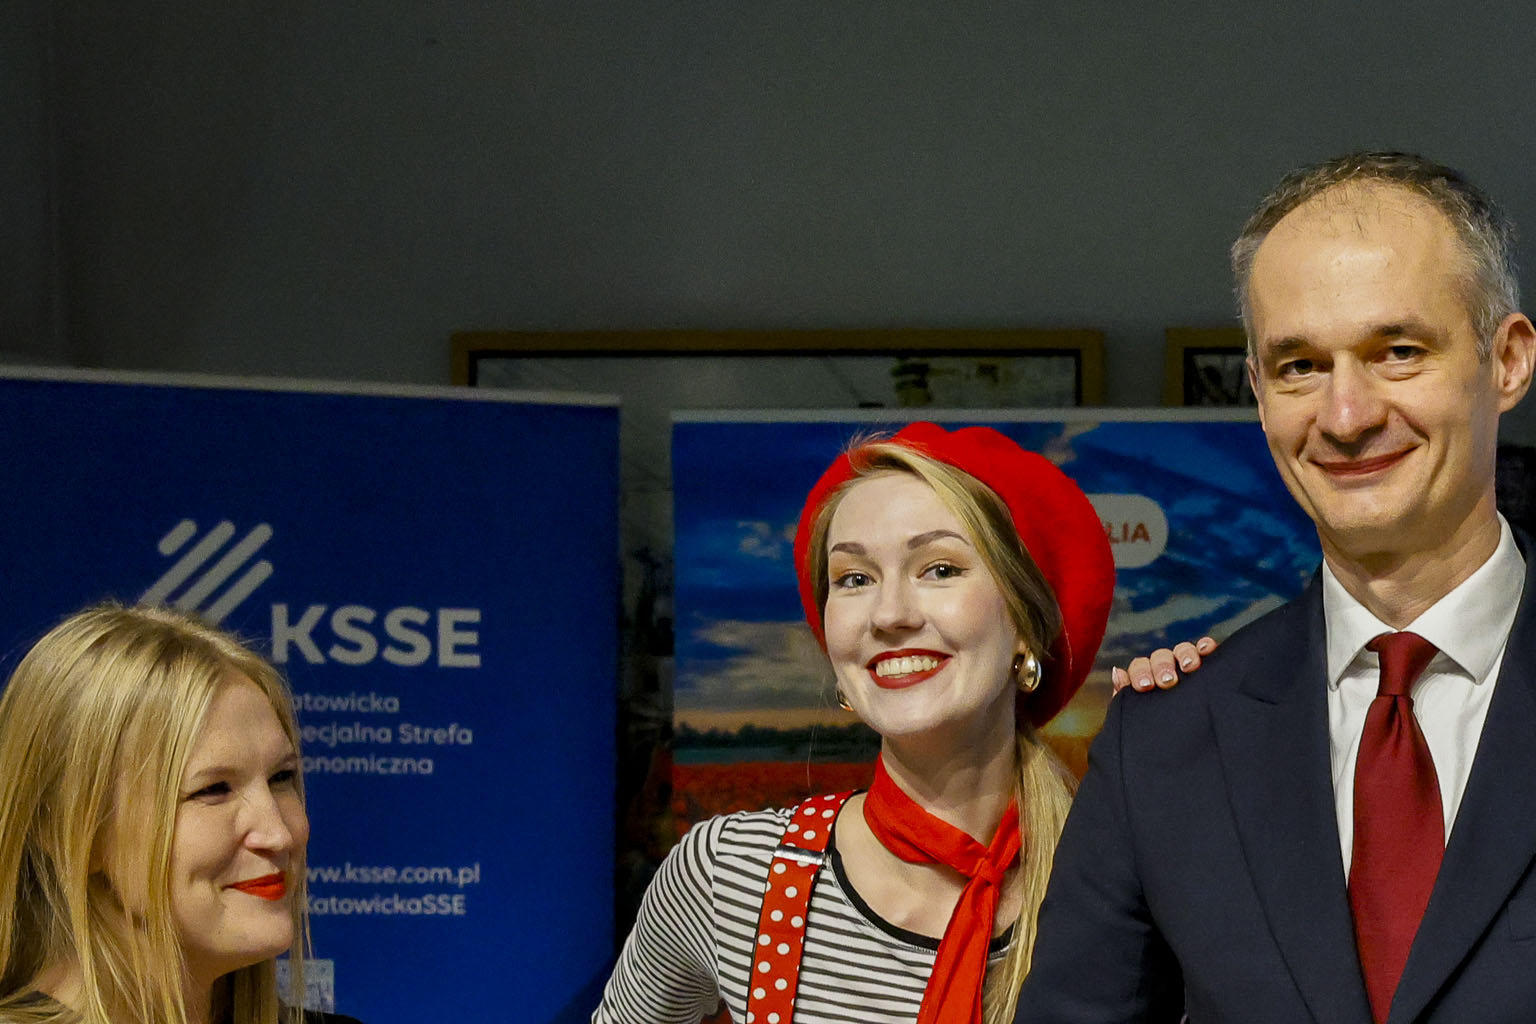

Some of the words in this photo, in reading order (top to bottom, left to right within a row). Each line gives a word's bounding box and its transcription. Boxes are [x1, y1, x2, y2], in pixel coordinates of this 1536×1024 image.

[271, 602, 482, 668] KSSE
[292, 692, 400, 713] atowicka
[300, 722, 392, 748] ecjalna
[399, 722, 473, 745] Strefa
[303, 752, 434, 774] onomiczna
